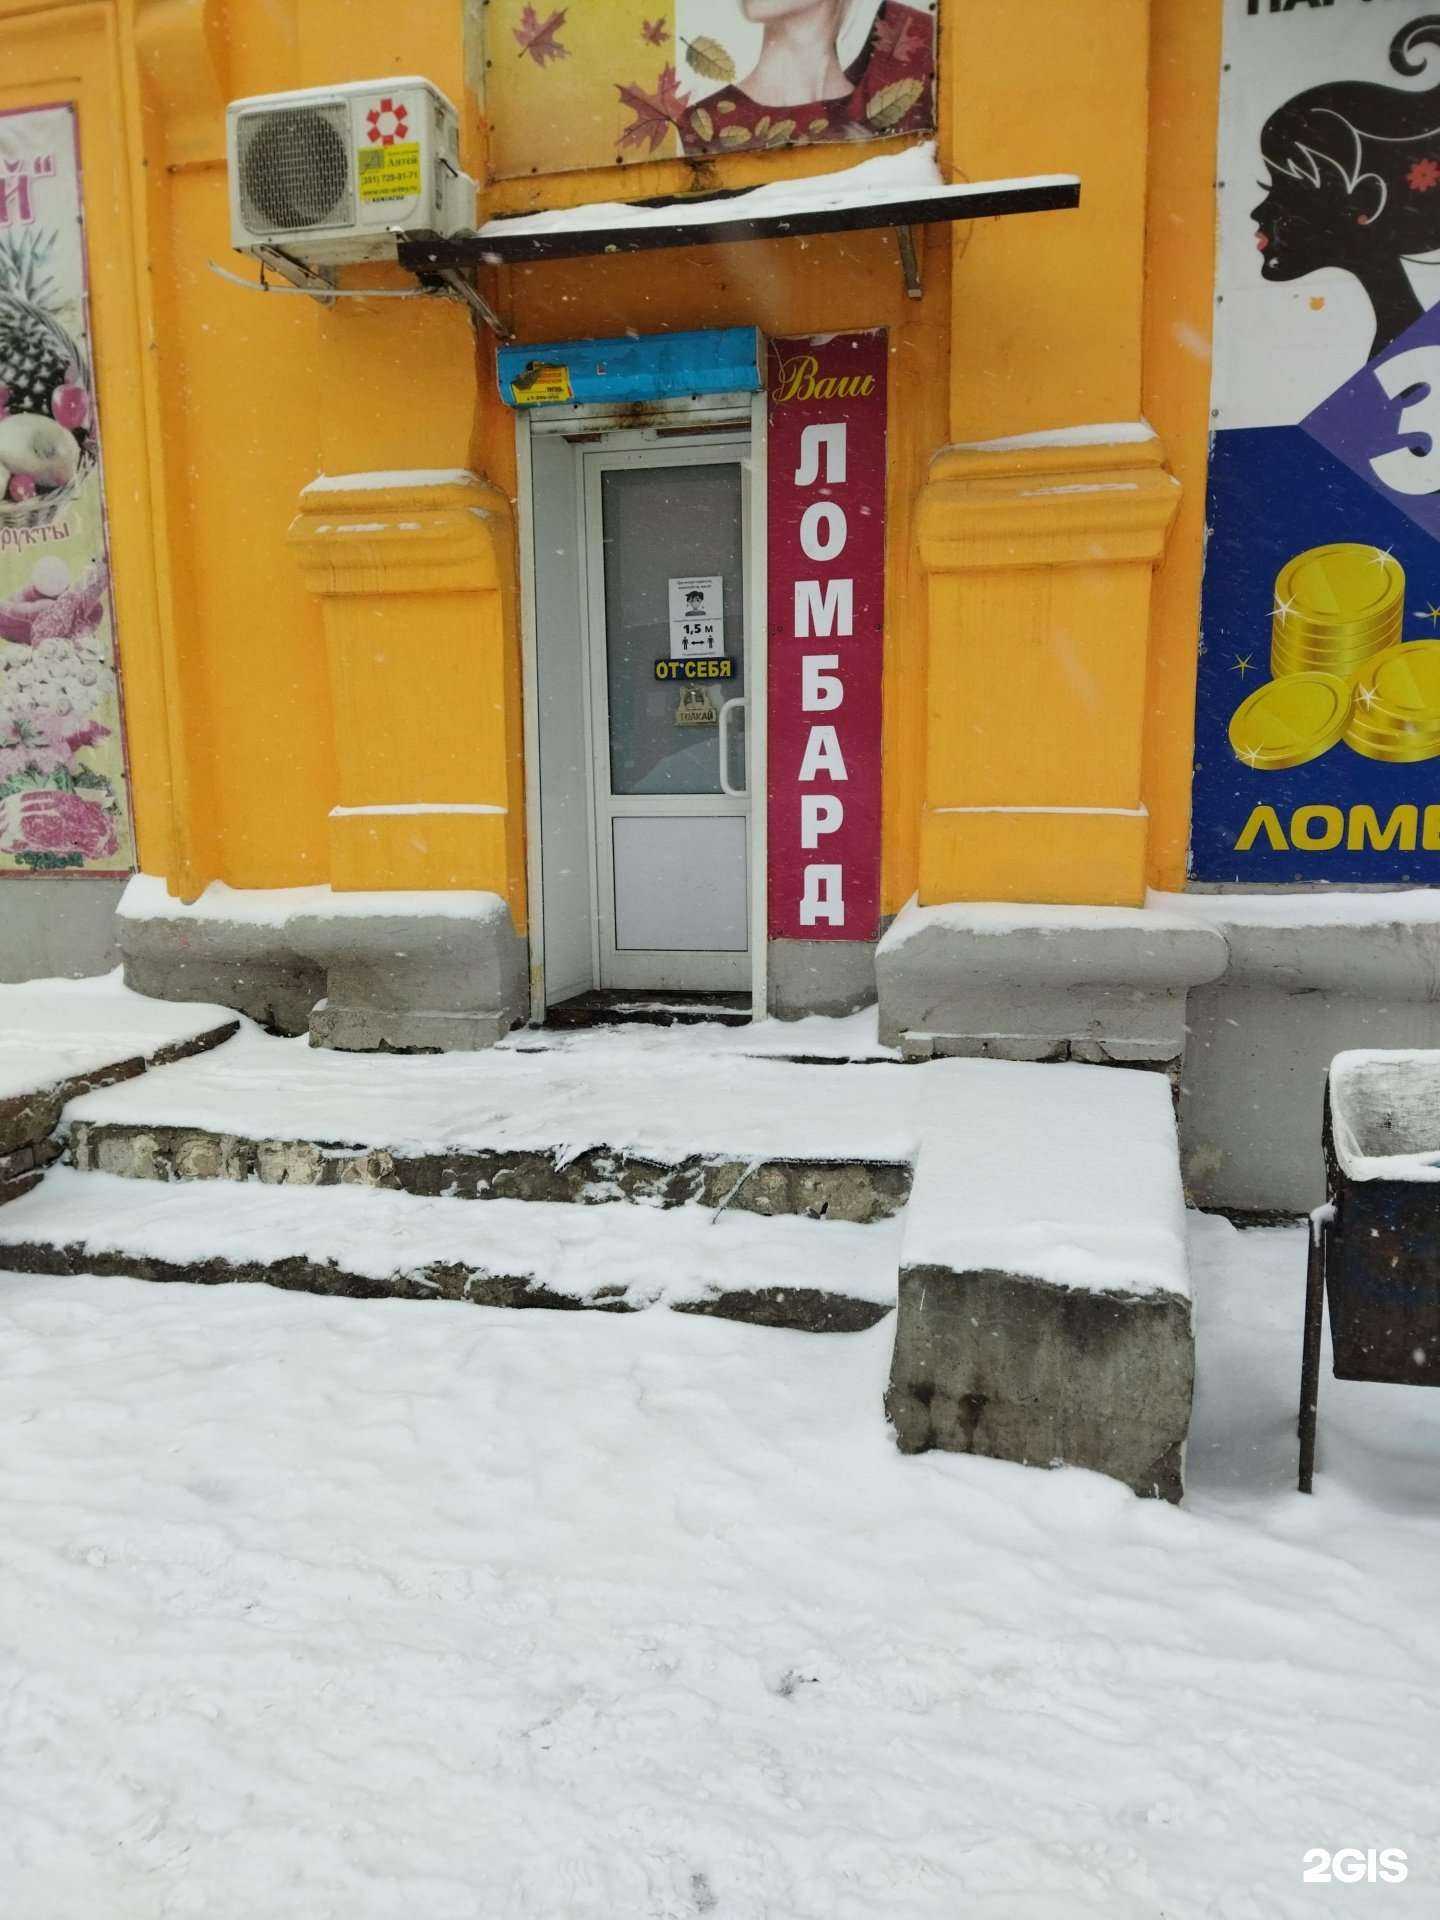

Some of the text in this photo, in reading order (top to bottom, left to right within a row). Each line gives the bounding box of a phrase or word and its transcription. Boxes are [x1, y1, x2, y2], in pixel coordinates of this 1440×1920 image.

[772, 356, 876, 402] Ваш
[683, 623, 702, 635] 1,5
[656, 660, 731, 679] ОТ СЕБЯ
[794, 422, 853, 926] ЛОМБАРД
